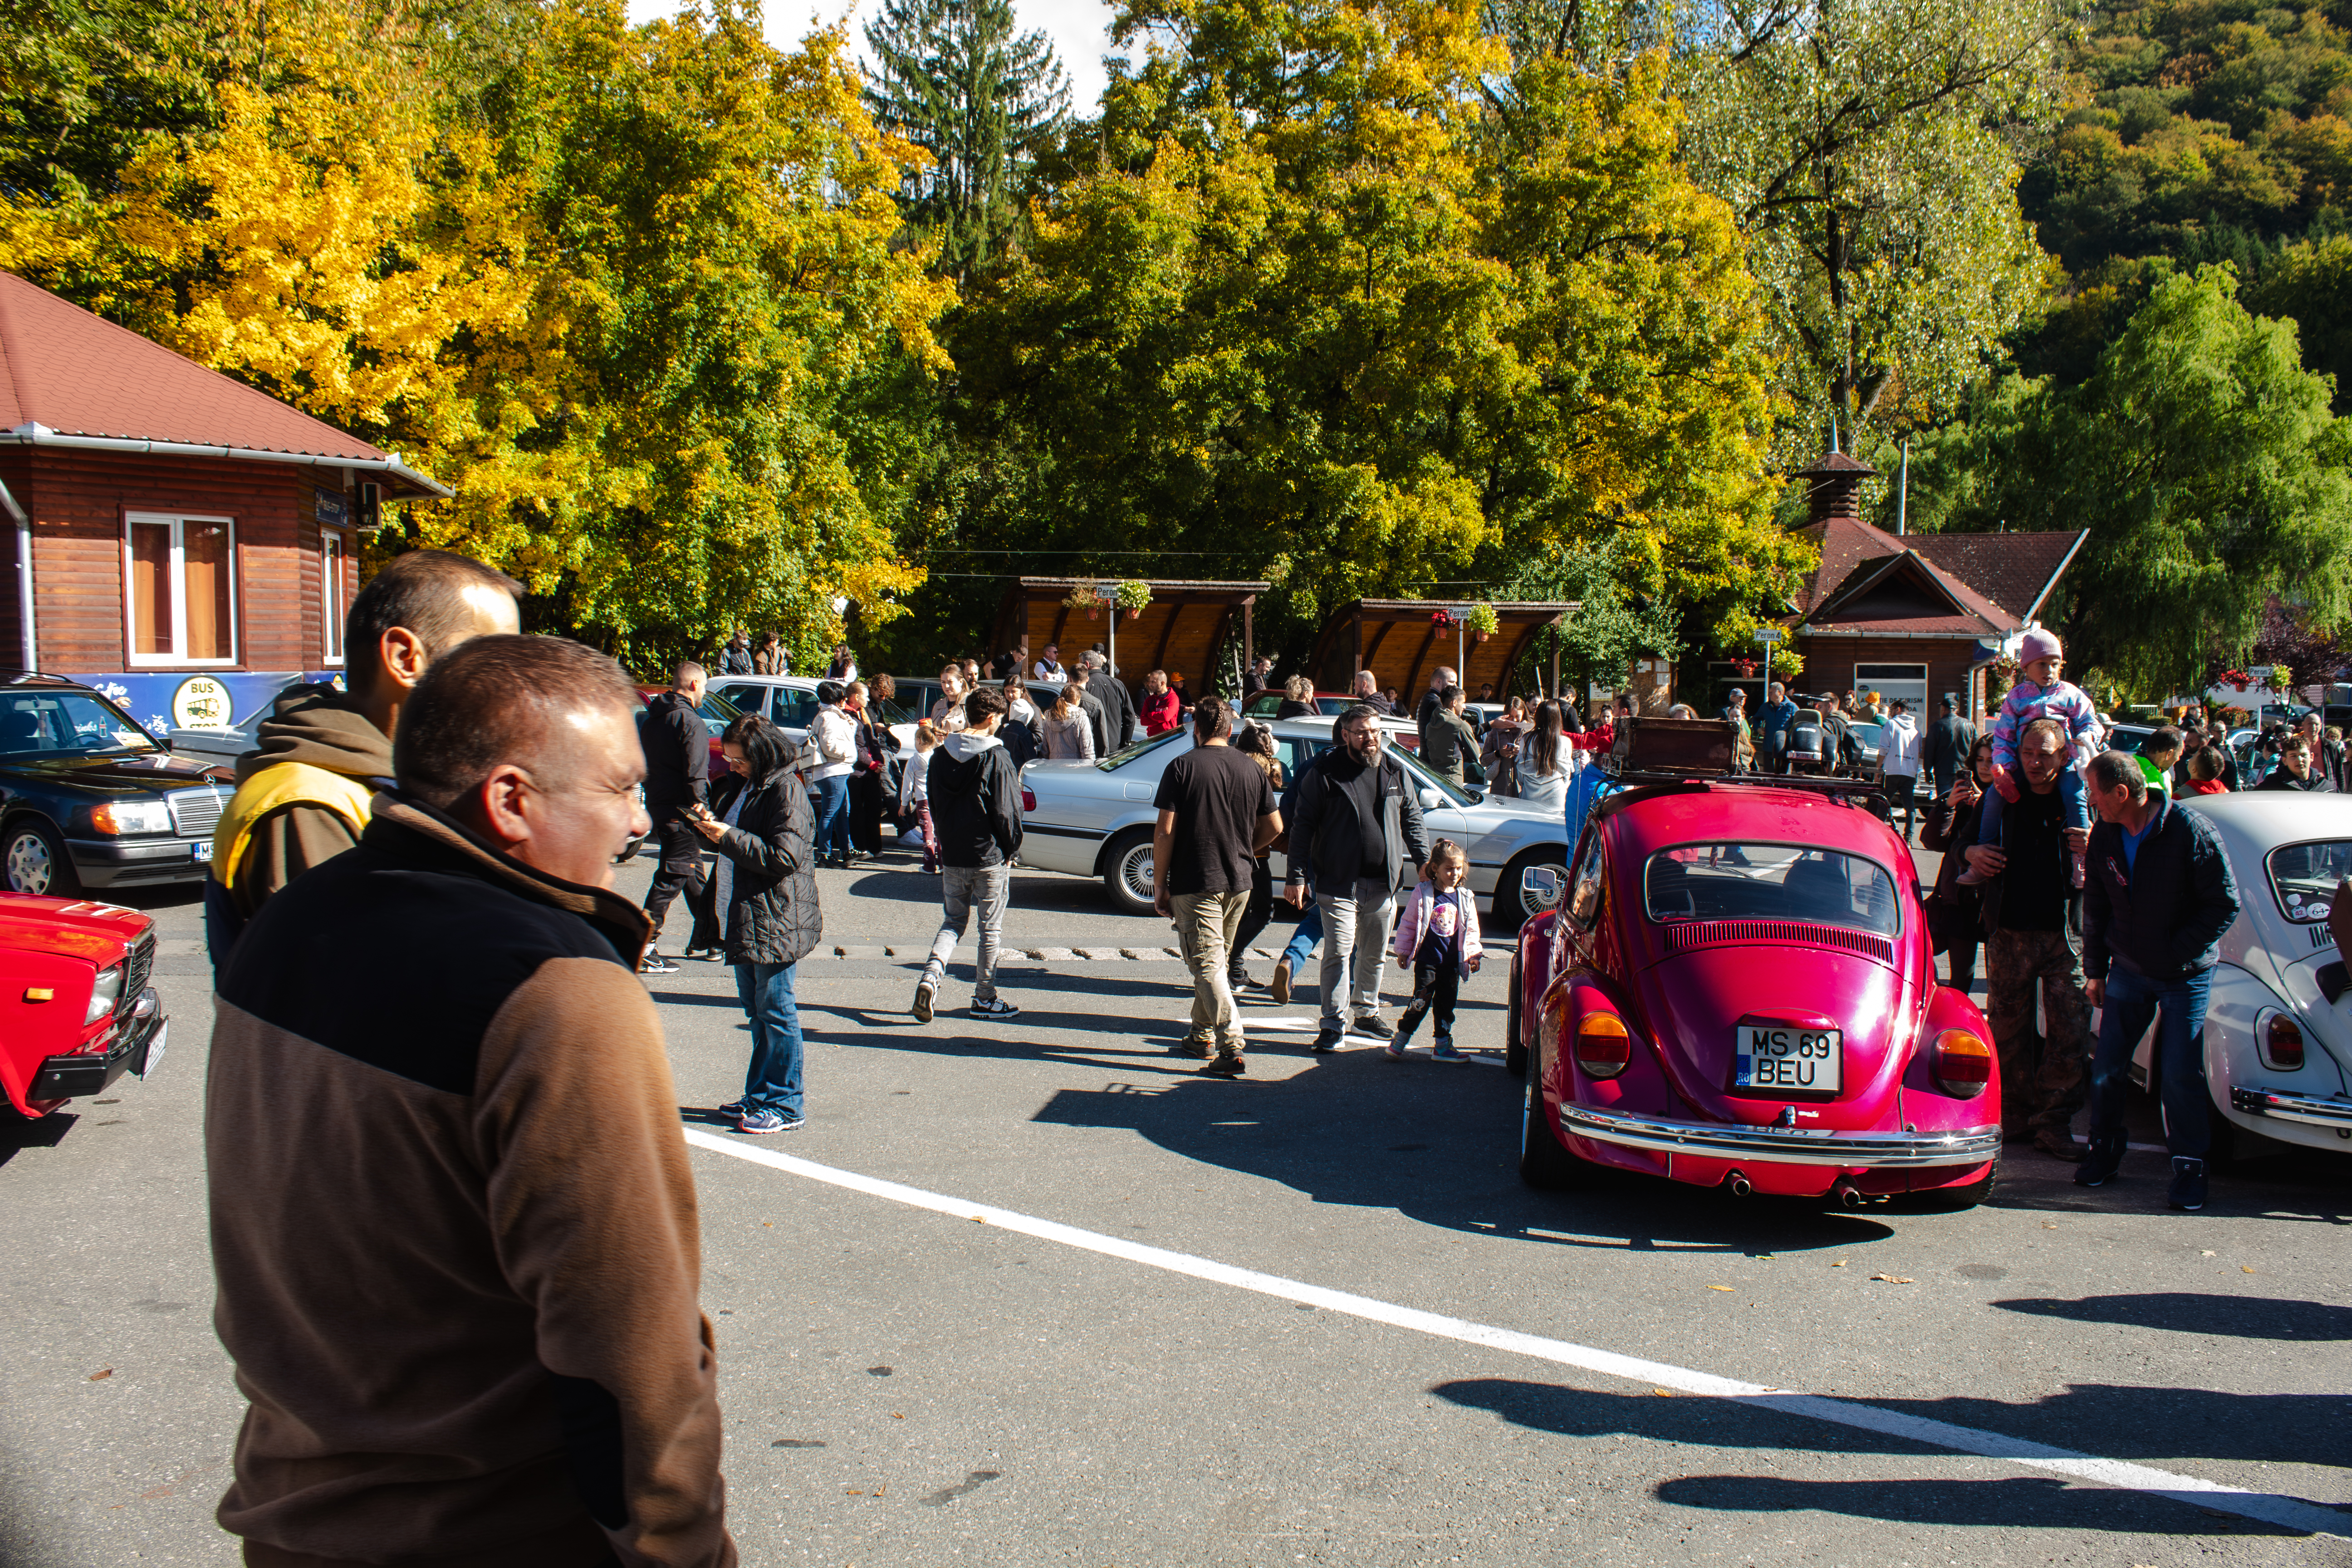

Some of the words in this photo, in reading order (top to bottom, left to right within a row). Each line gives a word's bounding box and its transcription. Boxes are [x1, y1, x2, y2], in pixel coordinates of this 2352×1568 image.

[1098, 588, 1117, 596] Peron
[1449, 609, 1468, 617] Peron
[191, 683, 214, 693] BUS
[1752, 1030, 1789, 1056] MS
[1799, 1033, 1831, 1059] 69
[1756, 1058, 1816, 1086] BEU
[1738, 1072, 1750, 1083] RO
